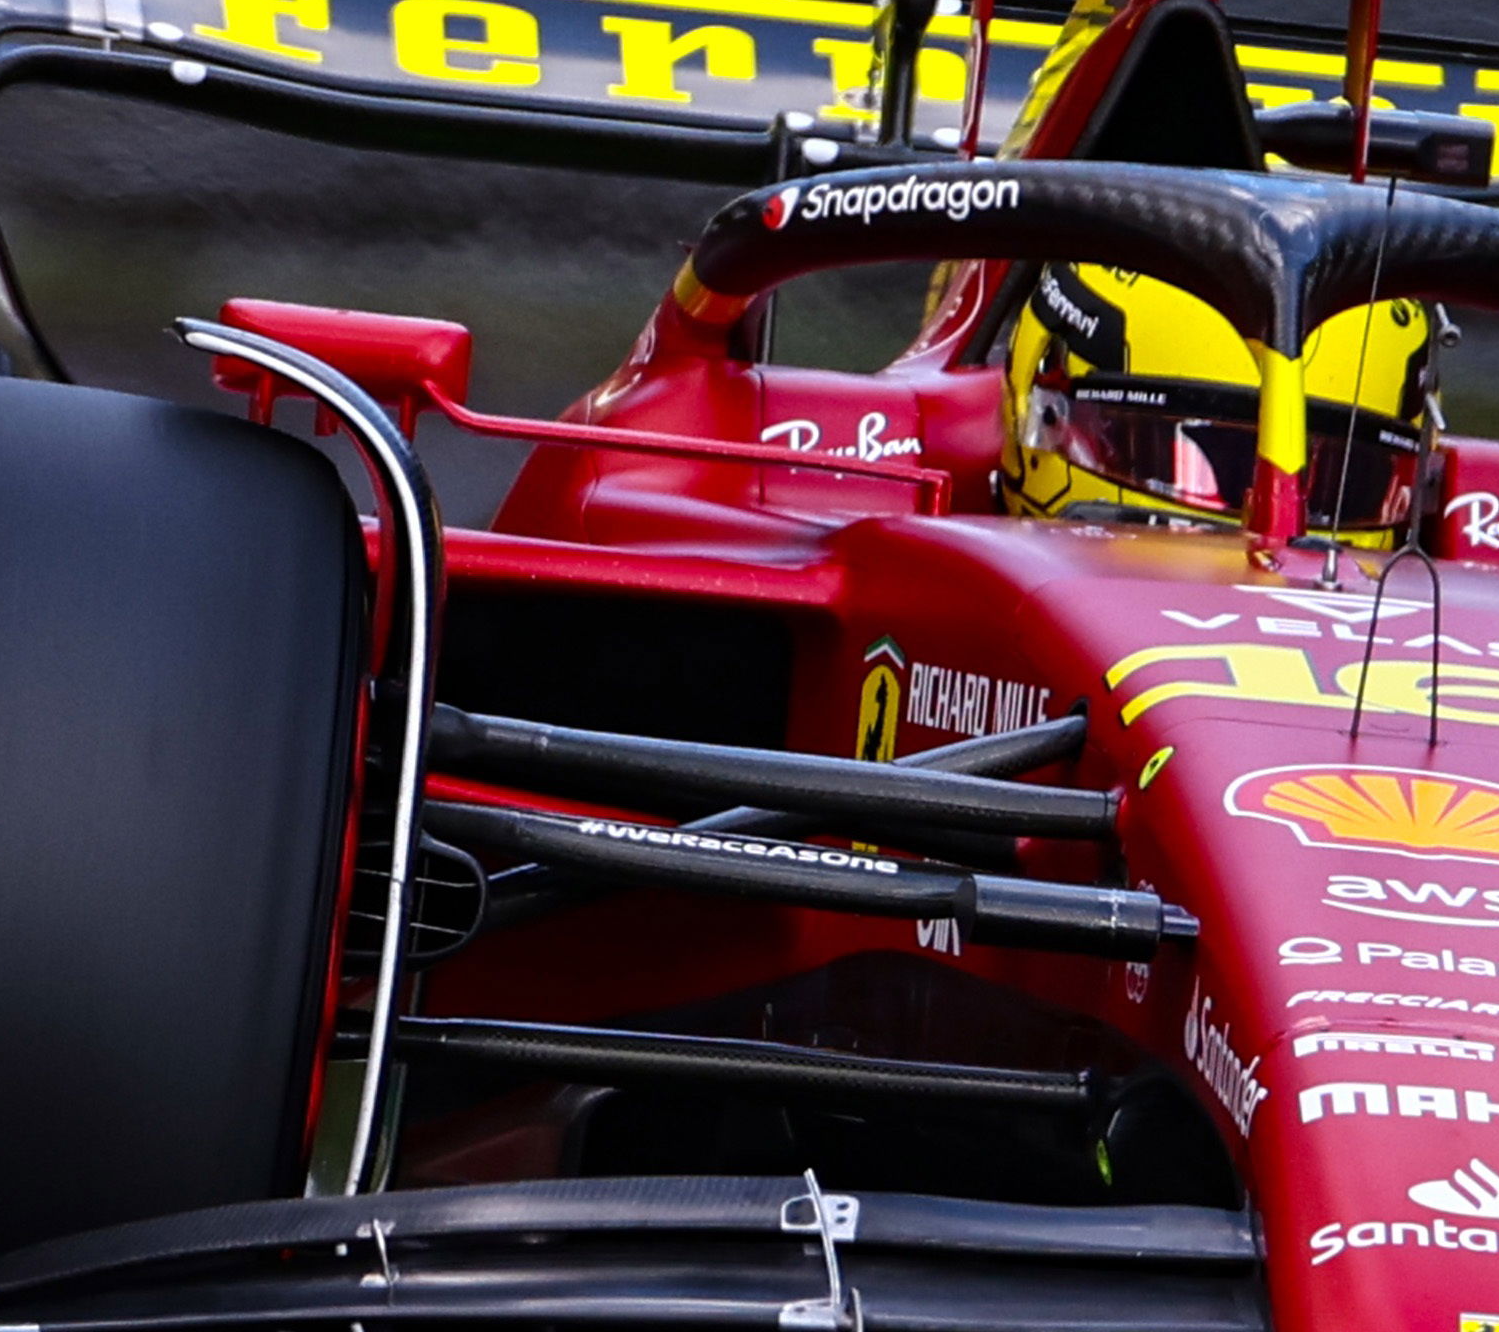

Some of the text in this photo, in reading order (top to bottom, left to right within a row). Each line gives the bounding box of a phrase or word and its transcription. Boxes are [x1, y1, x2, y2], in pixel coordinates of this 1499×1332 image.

[801, 175, 1019, 224] Snapdragon
[906, 662, 991, 737] RICHARD
[579, 819, 899, 874] #WeRaceAsOne
[1197, 996, 1268, 1139] Santander
[1293, 1032, 1495, 1061] PIRELLI
